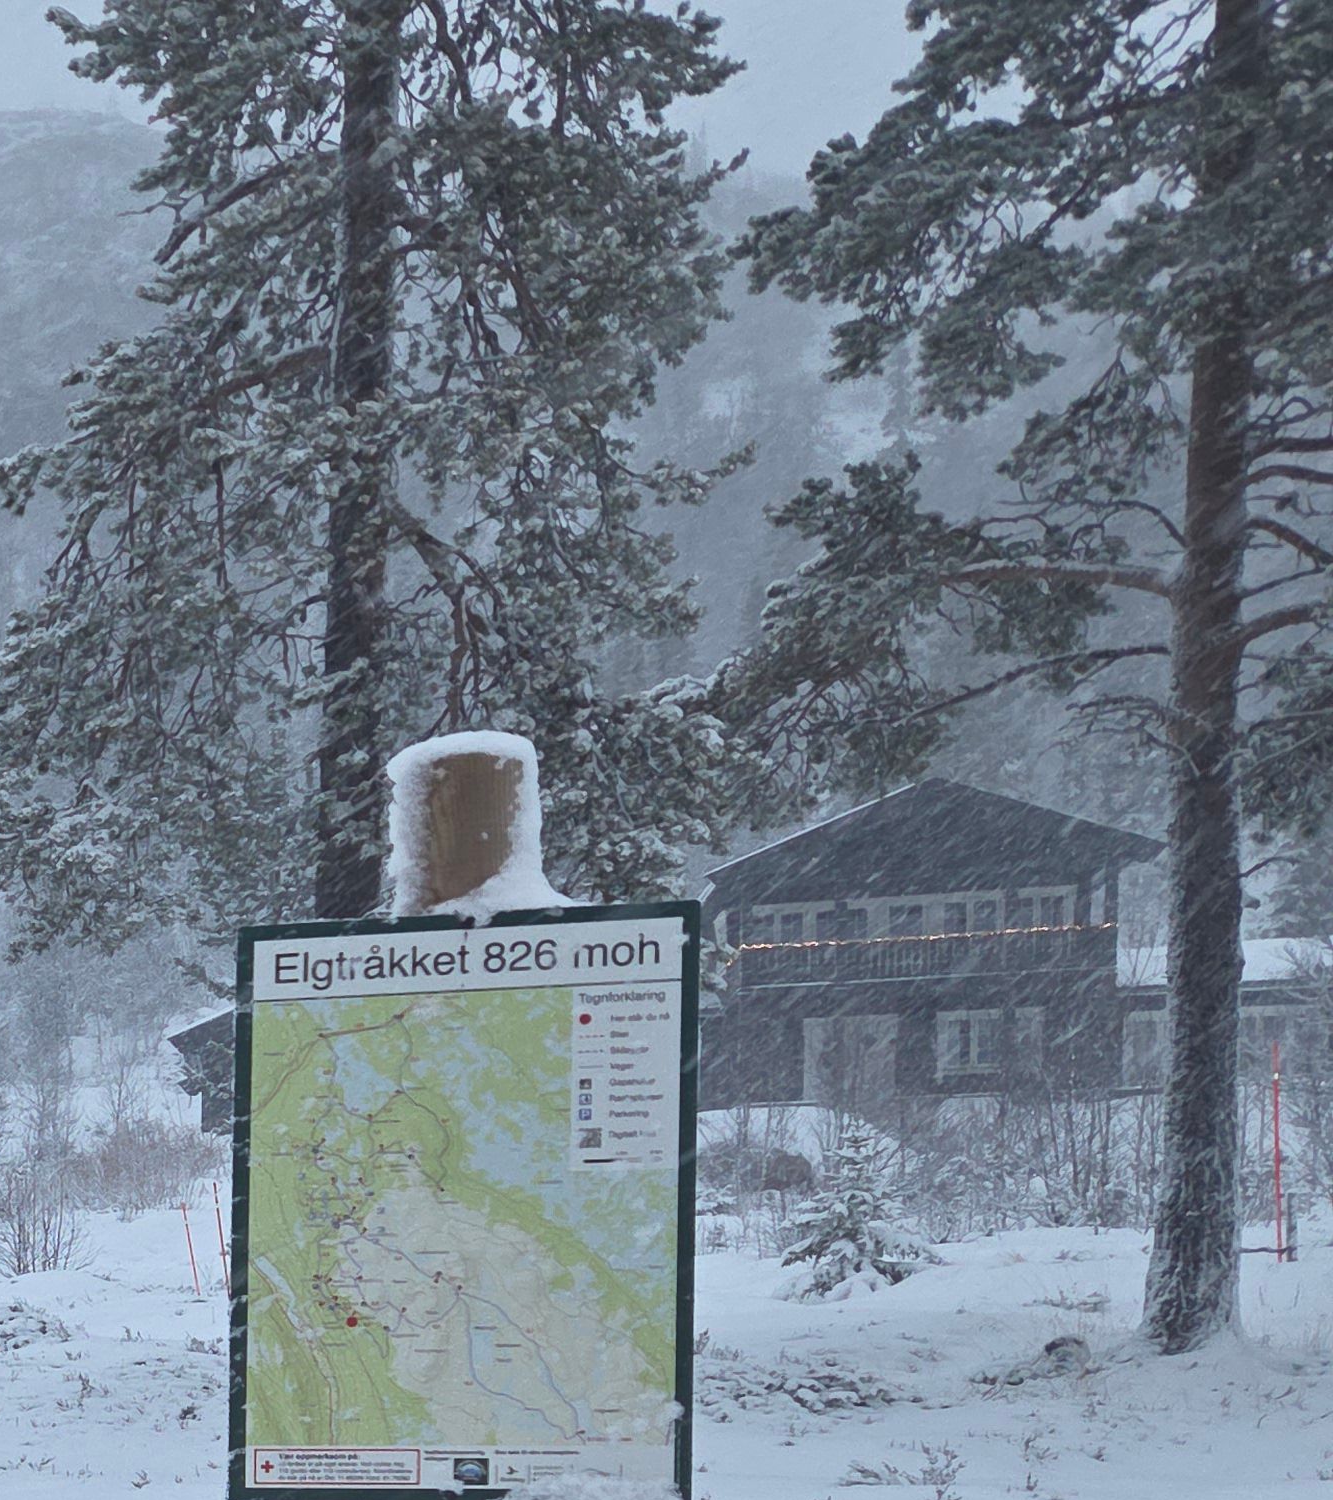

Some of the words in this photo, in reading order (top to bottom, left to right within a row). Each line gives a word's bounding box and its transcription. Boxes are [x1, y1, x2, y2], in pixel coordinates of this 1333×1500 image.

[274, 943, 470, 990] Elgtråkket
[483, 939, 558, 974] 826
[573, 933, 662, 968] moh
